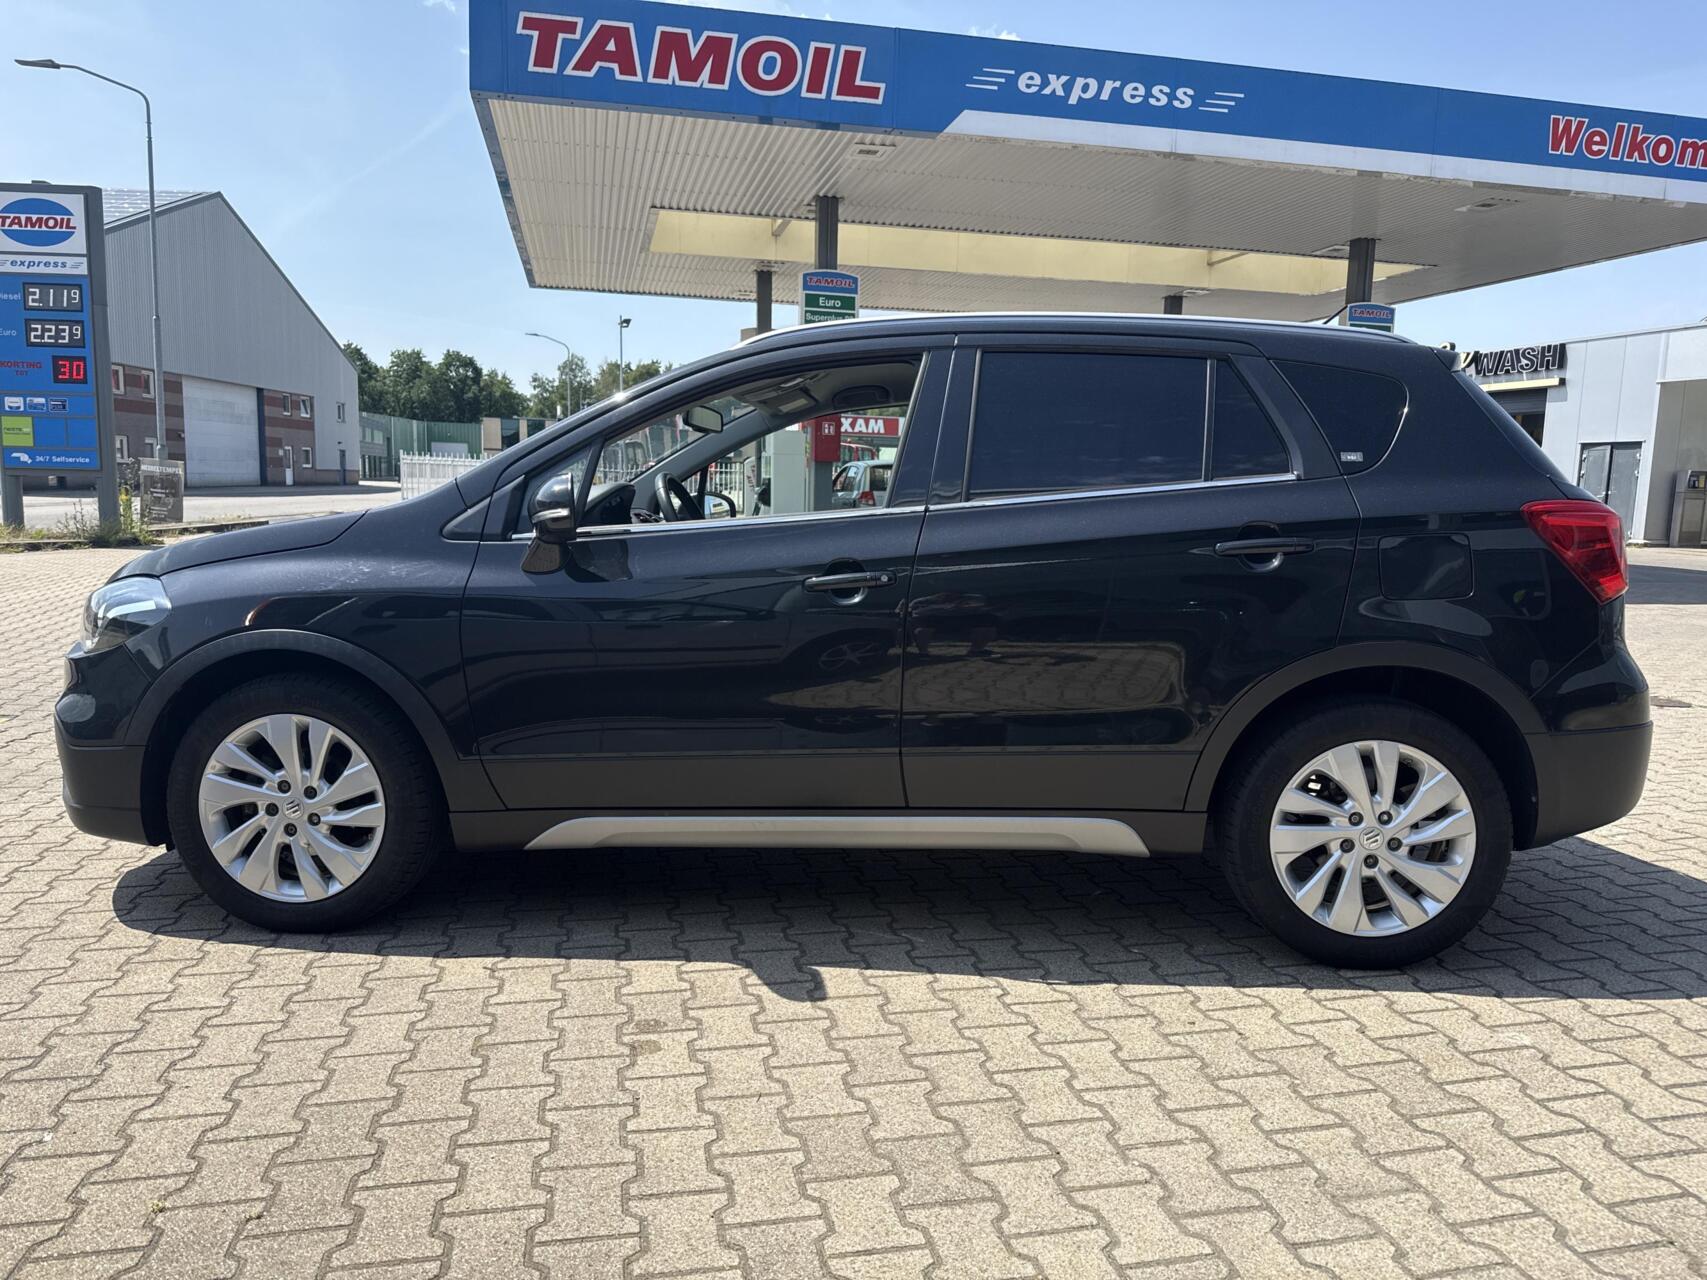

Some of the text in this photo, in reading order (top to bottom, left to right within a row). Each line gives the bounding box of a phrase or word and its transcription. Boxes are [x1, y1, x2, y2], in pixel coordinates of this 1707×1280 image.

[516, 11, 1707, 169] TAMOIL express Welkom
[0, 215, 77, 230] TAMOIL
[10, 260, 68, 269] express
[807, 276, 855, 288] TAMOIL
[0, 292, 21, 300] iesel
[819, 296, 841, 307] Euro
[1352, 308, 1392, 318] TAMOIL
[1478, 343, 1562, 376] WASH
[58, 361, 84, 379] 30
